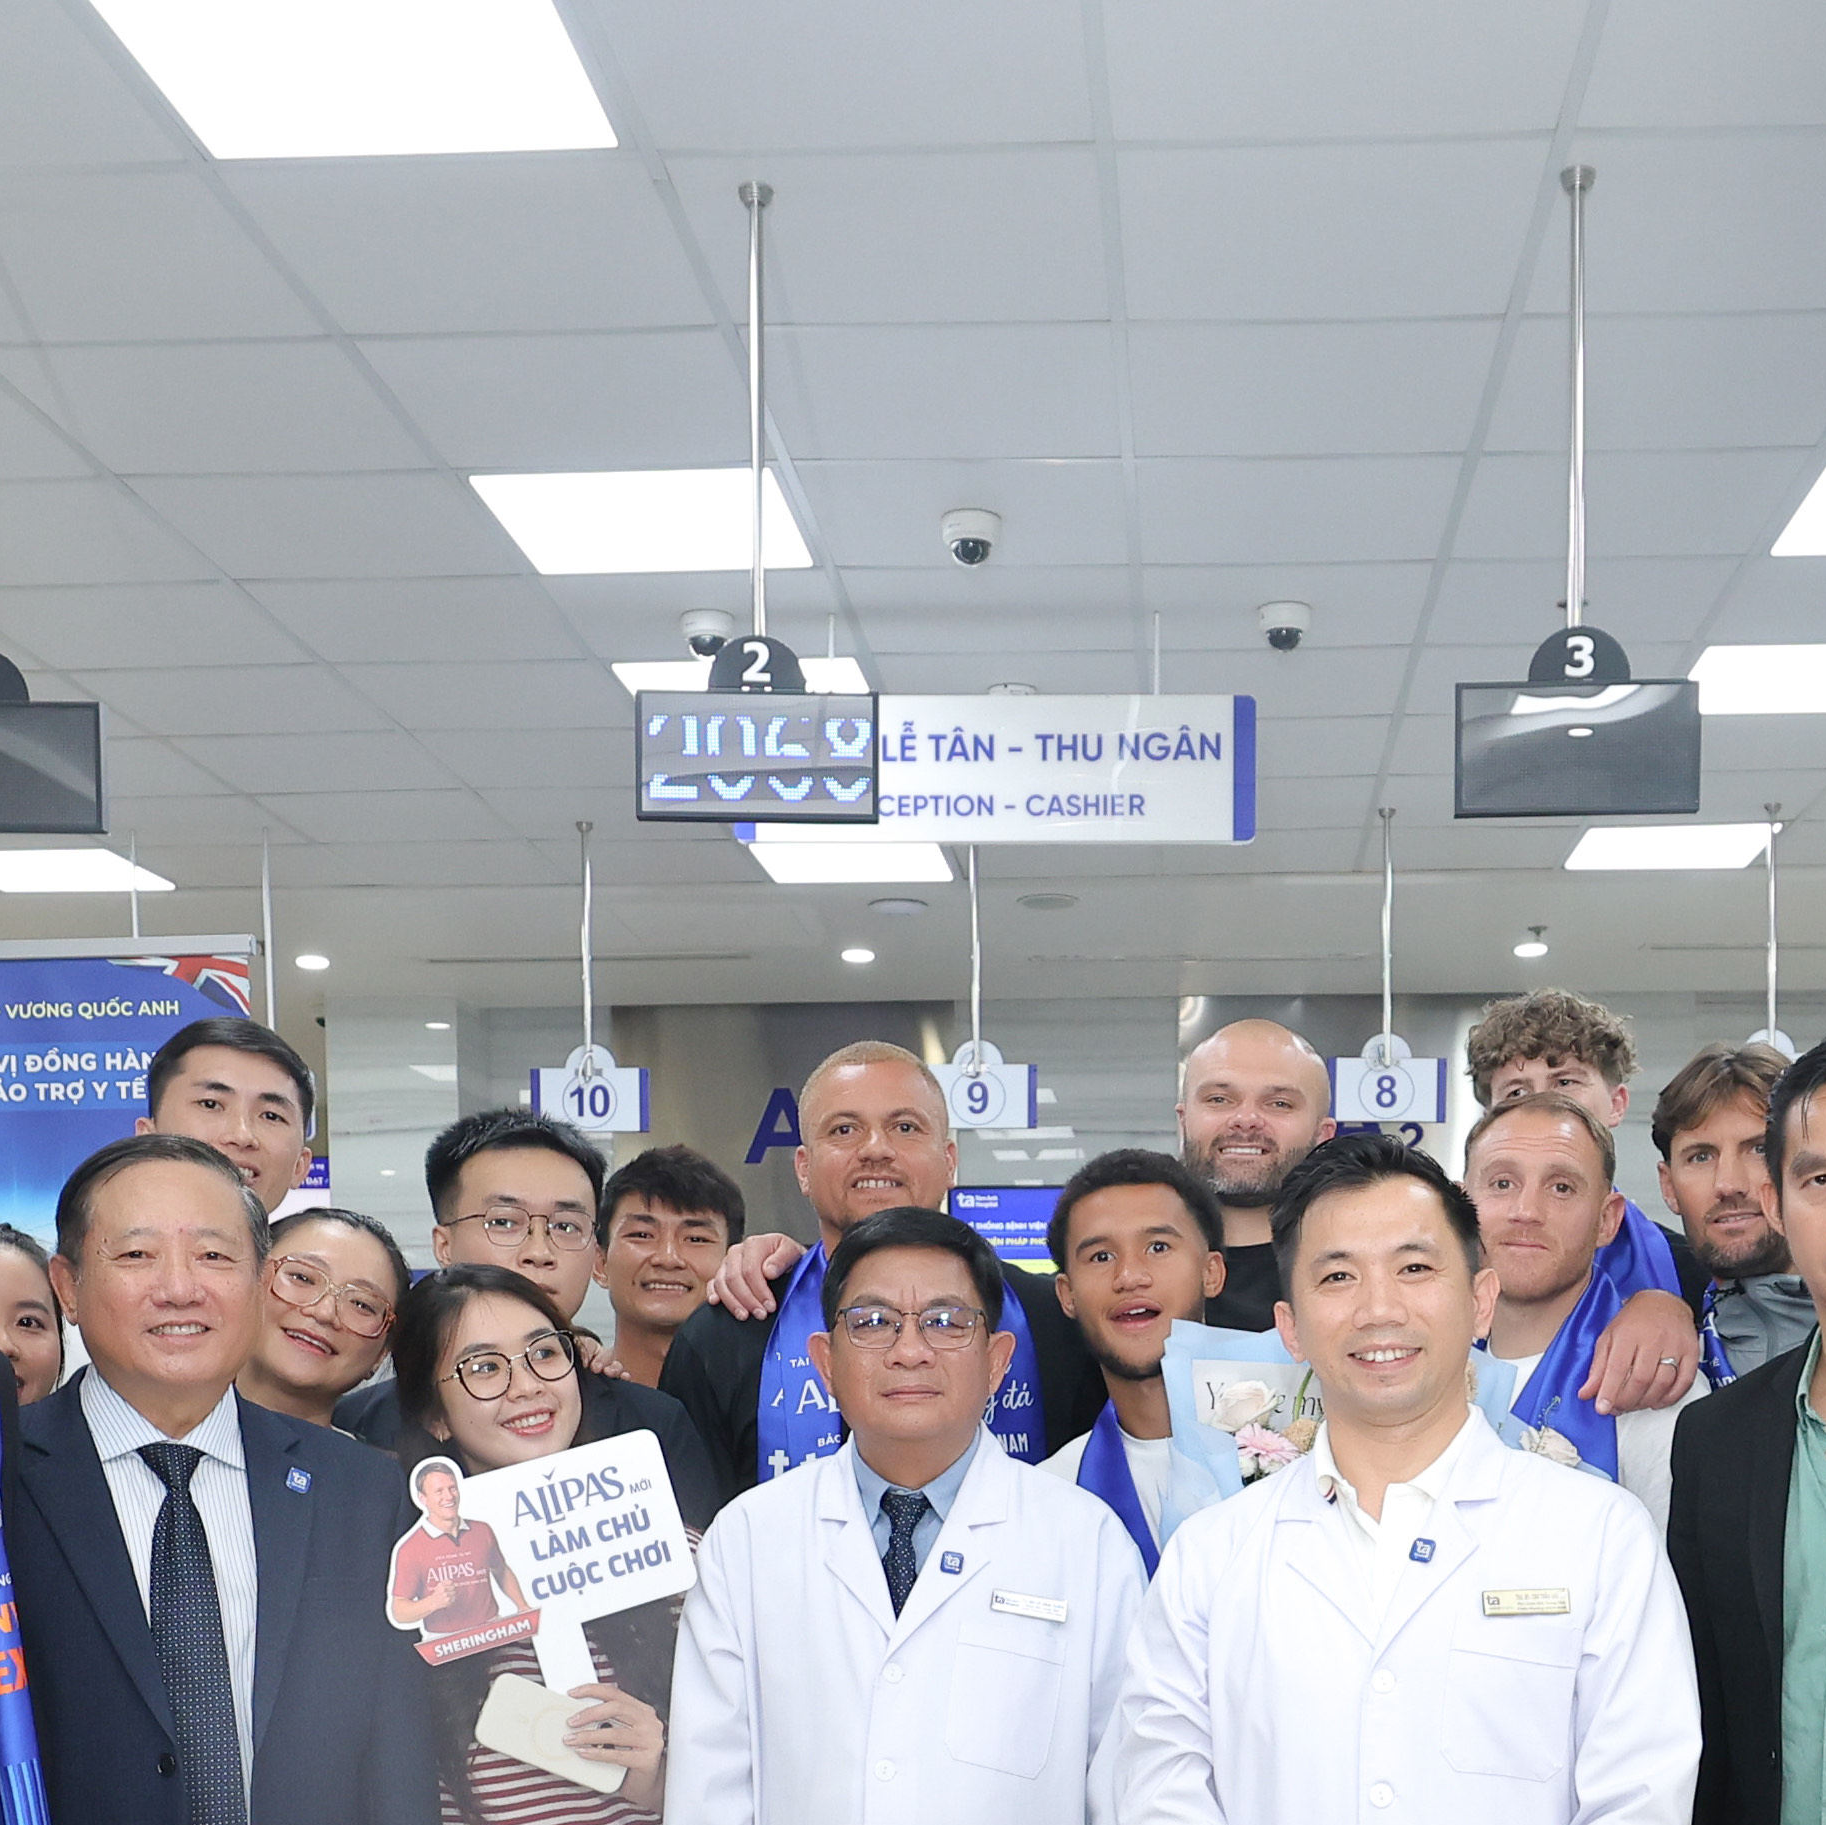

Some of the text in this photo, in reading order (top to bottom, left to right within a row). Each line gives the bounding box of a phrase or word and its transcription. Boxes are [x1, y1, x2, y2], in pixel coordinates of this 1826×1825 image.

[742, 641, 771, 682] 2
[1565, 635, 1595, 677] 3
[881, 721, 917, 762] LỄ
[928, 727, 995, 762] TÂN
[1035, 734, 1104, 762] THU
[1118, 724, 1222, 762] NGÂN
[1025, 794, 1146, 817] CASHIER
[4, 1000, 74, 1020] VƯƠNG
[77, 996, 134, 1021] QUỐC
[138, 1000, 181, 1017] ANH
[24, 1048, 98, 1074] ĐỒNG
[34, 1078, 86, 1105] TRỢ
[92, 1081, 110, 1100] Y
[116, 1074, 149, 1100] TẾ
[569, 1084, 610, 1118] 10
[966, 1083, 990, 1114] 9
[1375, 1075, 1397, 1108] 8
[530, 1503, 652, 1562] LÀM CHỦ
[531, 1540, 672, 1601] CUỘC CHƠI
[995, 1594, 1005, 1605] ta
[1486, 1594, 1500, 1606] ta
[434, 1618, 532, 1659] SHERINGHAM
